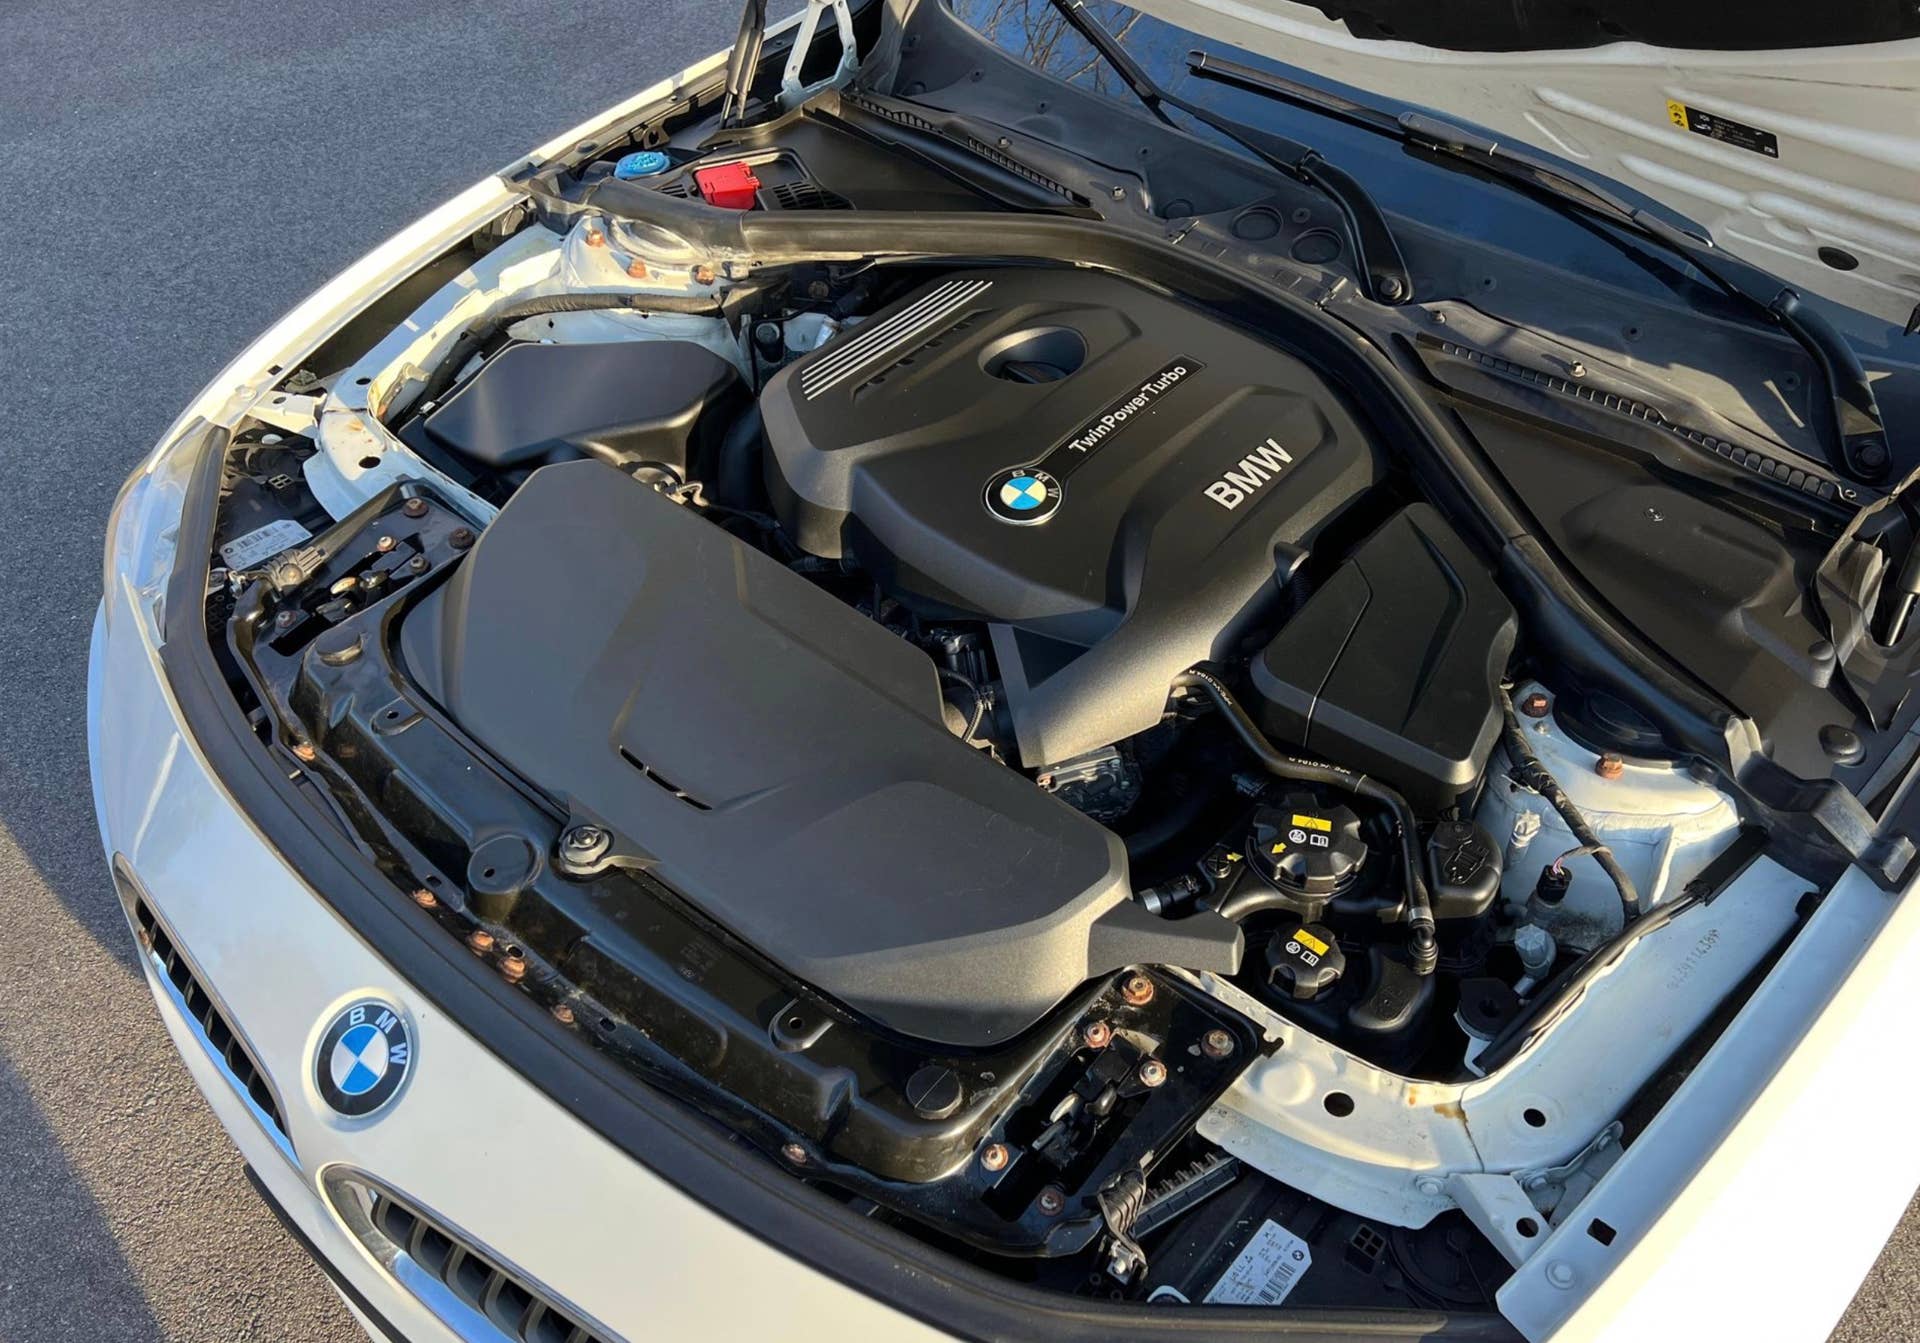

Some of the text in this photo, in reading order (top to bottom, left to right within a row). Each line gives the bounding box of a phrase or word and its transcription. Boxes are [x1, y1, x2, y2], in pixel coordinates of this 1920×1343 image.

[1011, 469, 1059, 498] BMW
[1203, 438, 1294, 511] BMW
[349, 1006, 408, 1065] BMW
